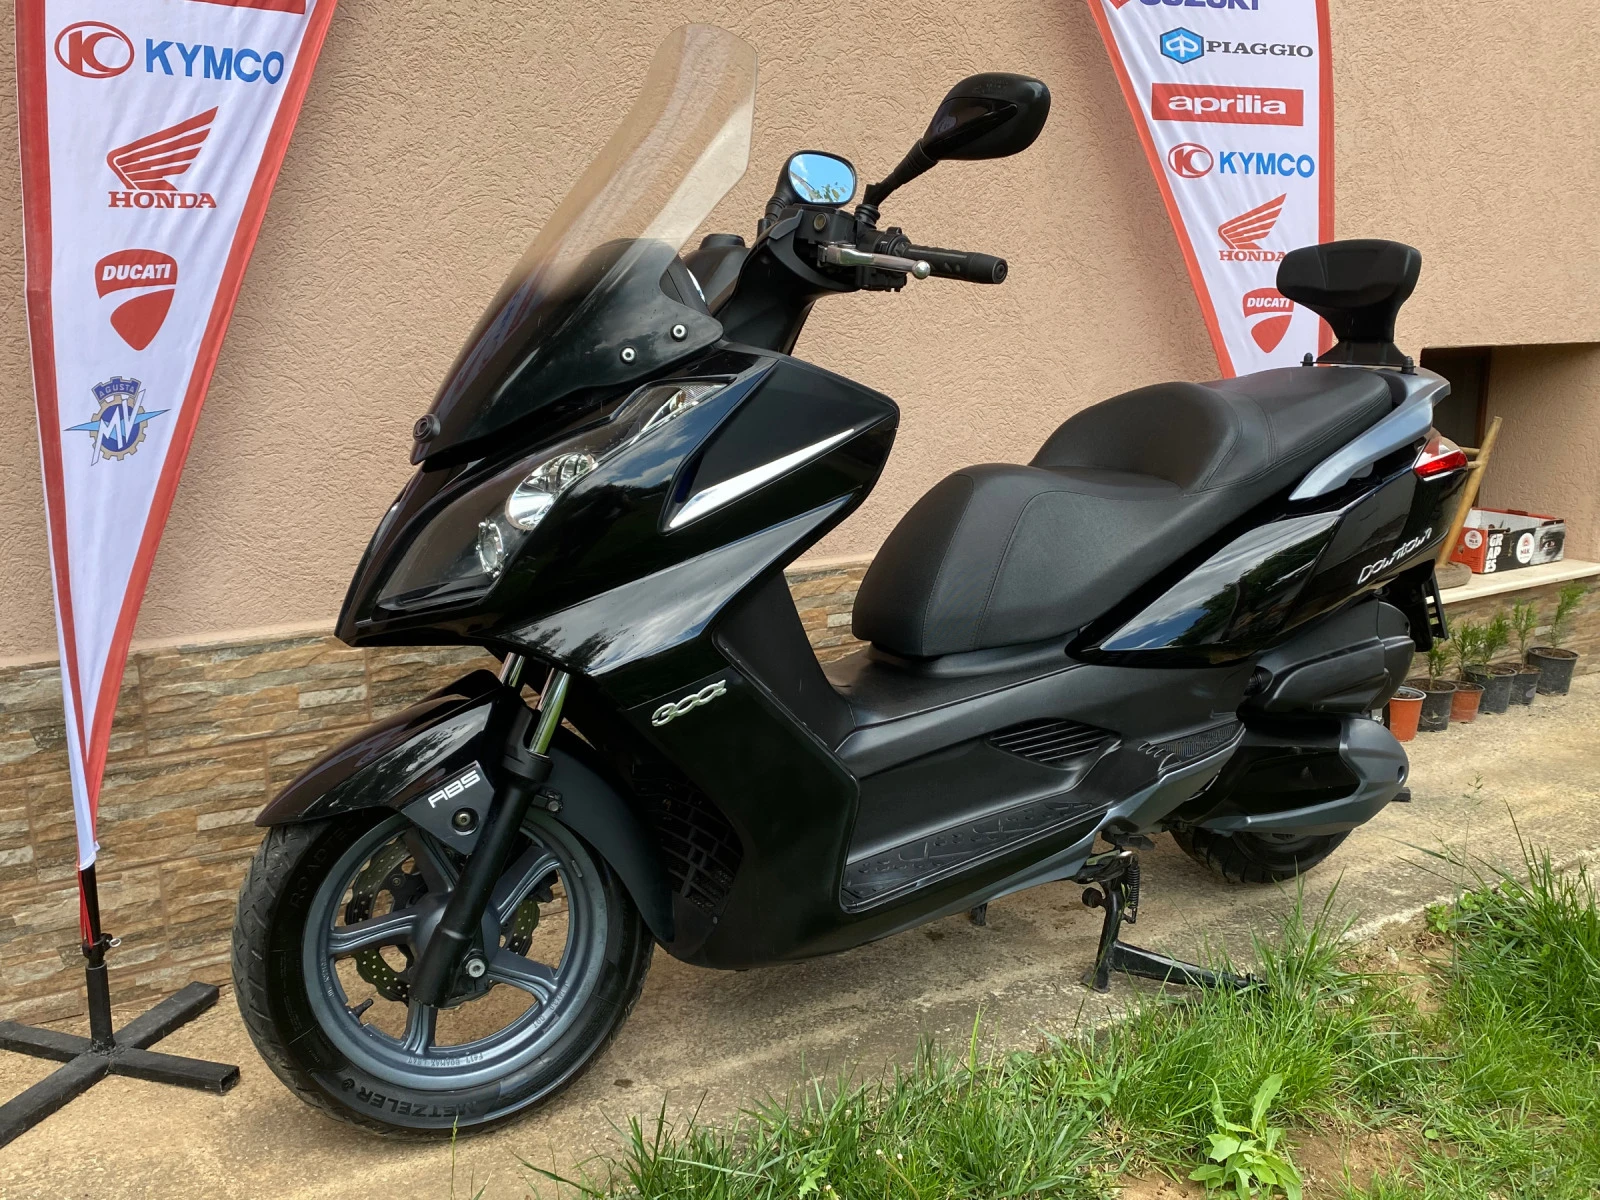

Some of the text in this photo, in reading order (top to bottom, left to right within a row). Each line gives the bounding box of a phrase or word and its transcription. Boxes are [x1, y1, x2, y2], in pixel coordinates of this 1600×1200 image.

[1206, 40, 1313, 58] PIAGGIO
[145, 38, 285, 84] KYMCO
[1168, 94, 1286, 115] aprilia
[1219, 151, 1315, 178] KYMCO
[108, 191, 217, 209] HONDA
[102, 263, 171, 281] DUCATI
[1246, 297, 1291, 308] DUCATI
[98, 383, 135, 398] AGUSTA
[91, 389, 147, 466] MV
[428, 770, 480, 808] ABS
[356, 1086, 477, 1118] METZELER
